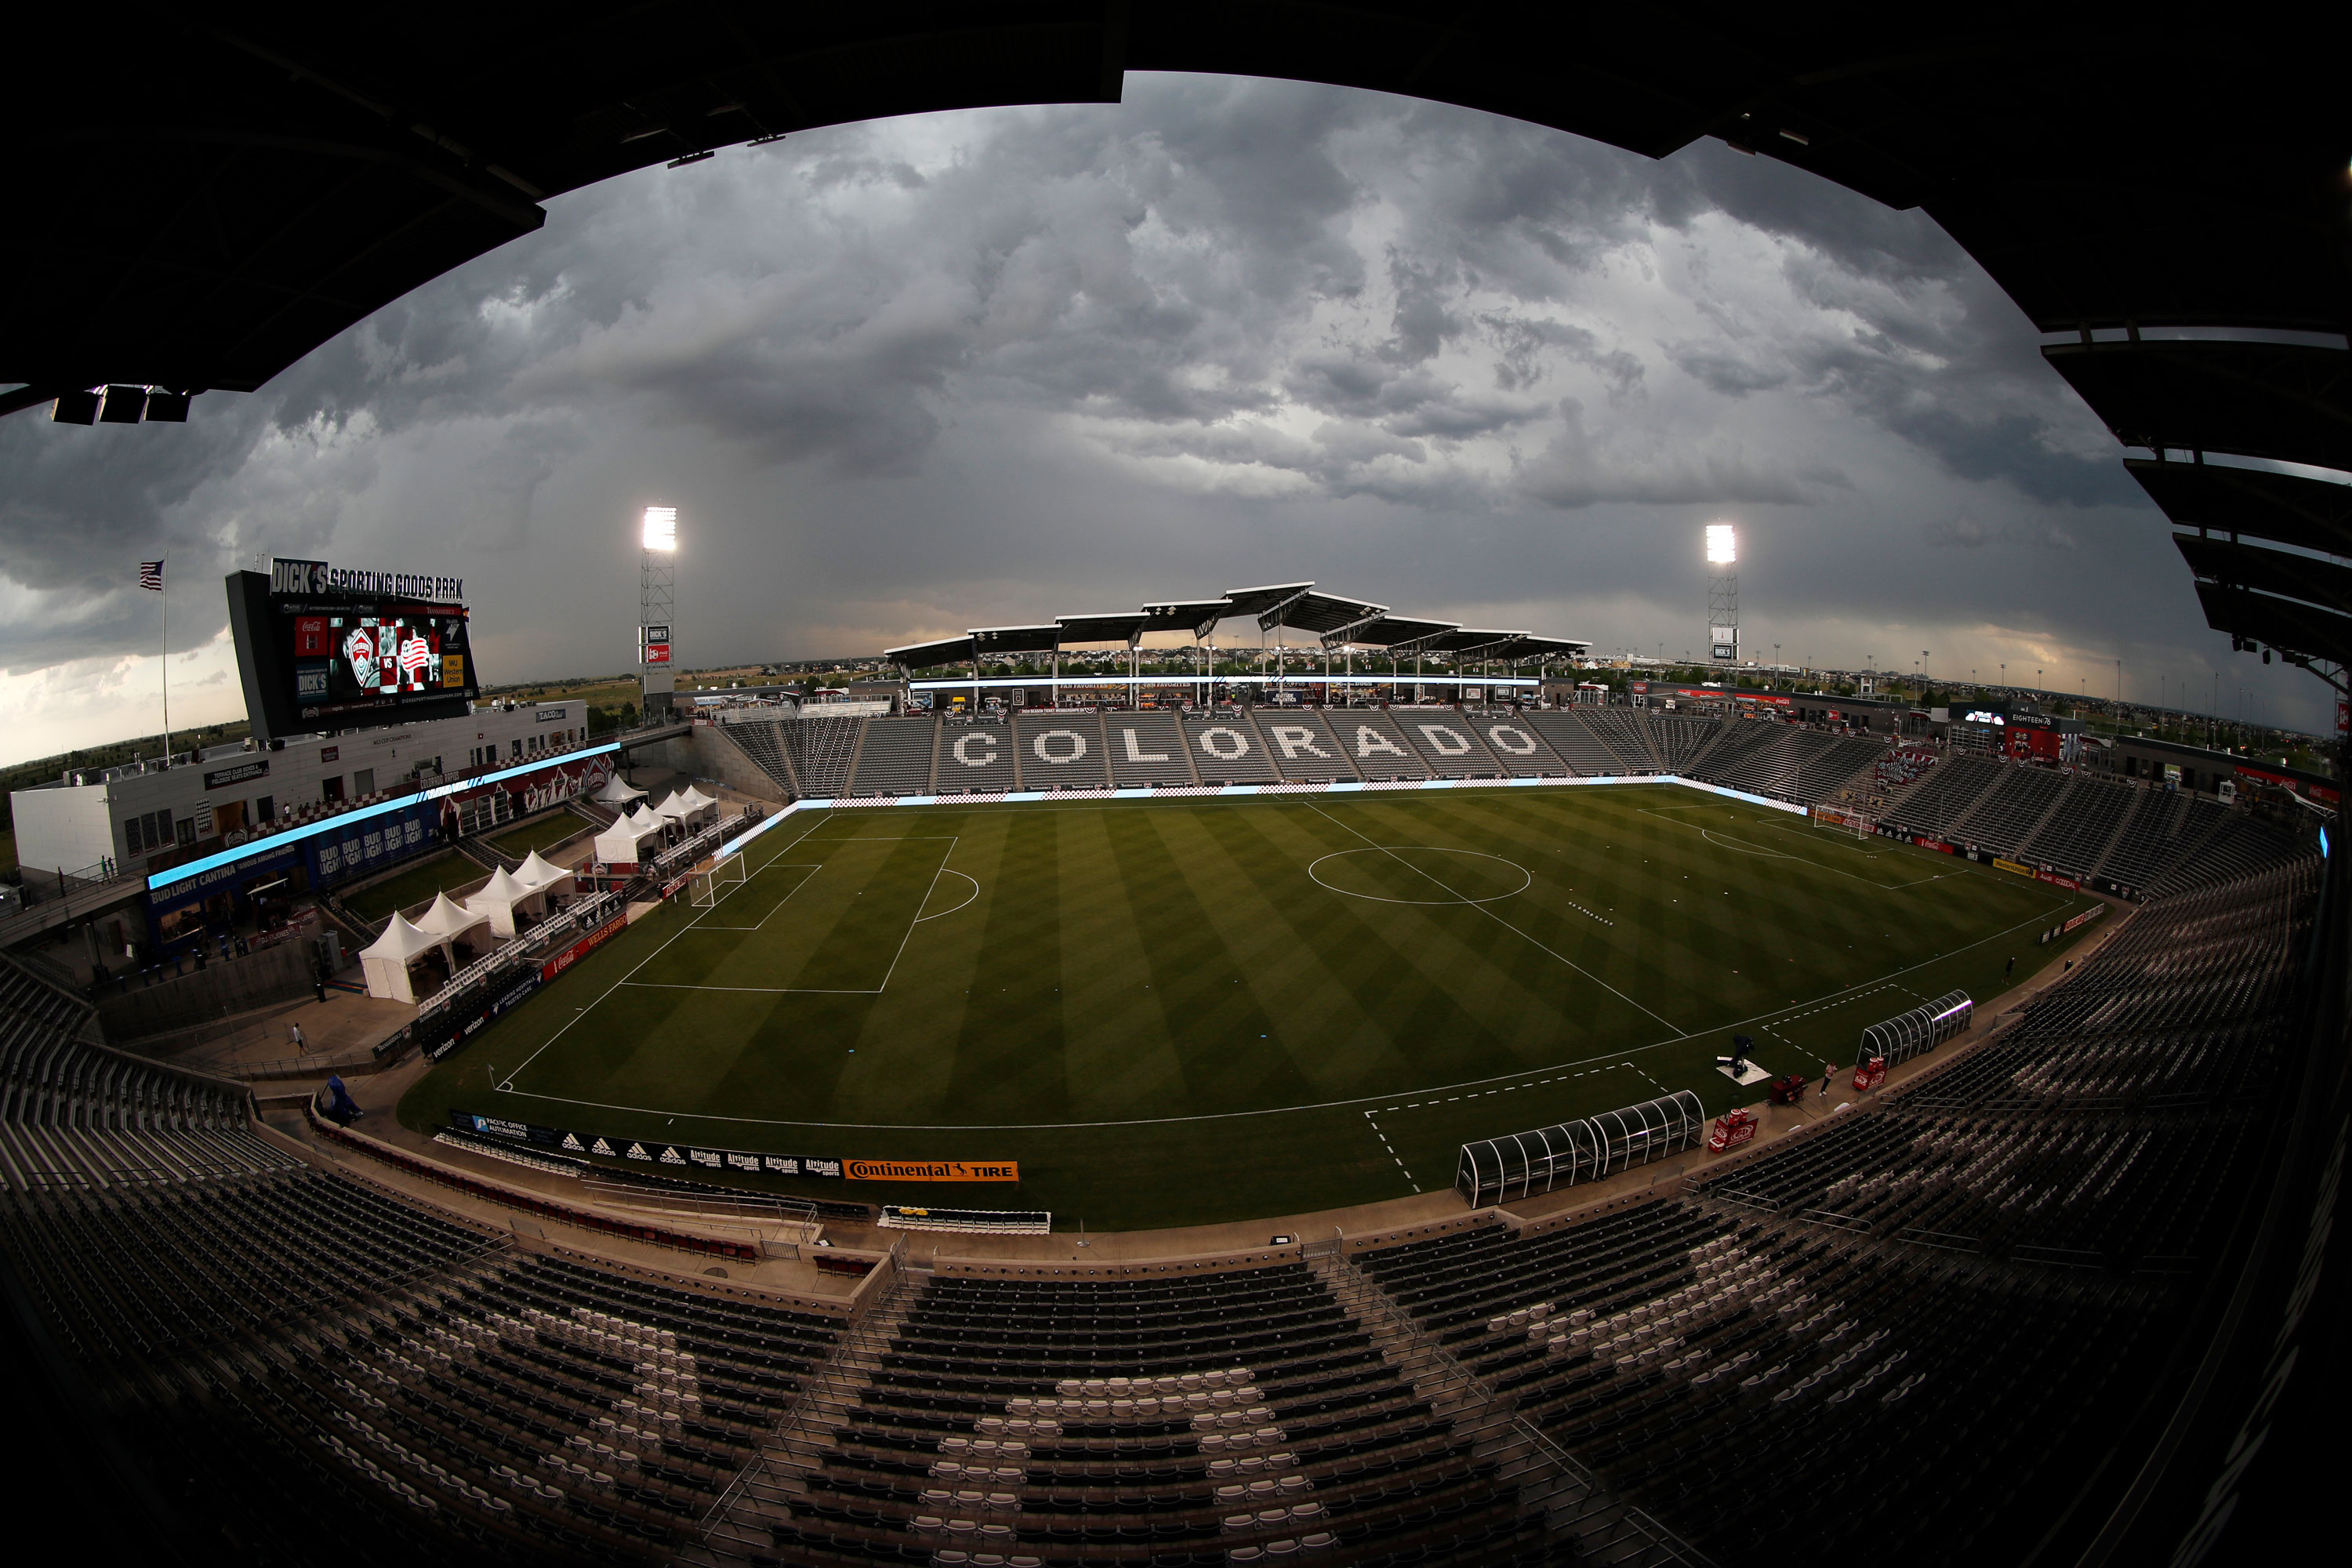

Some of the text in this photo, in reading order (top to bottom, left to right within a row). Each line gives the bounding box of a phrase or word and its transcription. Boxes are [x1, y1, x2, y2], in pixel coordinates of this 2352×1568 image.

[271, 561, 463, 599] DICK'S SPORTING GOODS PARK
[383, 658, 393, 668] VS
[299, 673, 327, 691] DICK'S
[539, 710, 556, 720] TACO
[2013, 714, 2051, 726] EIGHTEEN 76
[389, 734, 412, 743] CHAMPIONS
[953, 725, 1536, 767] COLORADO
[212, 768, 263, 786] FIELDSIDE SEATS ENTRANCE
[214, 770, 231, 779] TERRACE
[420, 775, 444, 789] COLORADO
[384, 825, 401, 840] BUD
[404, 818, 420, 833] BUD
[364, 831, 381, 847] BUD
[342, 838, 361, 855] BUD
[257, 851, 275, 864] AMONG
[275, 845, 295, 858] FRIENDS
[320, 846, 339, 862] BUD
[151, 865, 236, 905] BUD LIGHT CANTINA
[588, 915, 627, 947] WELLS FARGO
[499, 989, 516, 1005] LEADING
[505, 993, 522, 1007] TRUSTED
[463, 1016, 485, 1035] verizon
[376, 1032, 402, 1052] TRANSAMERICA
[433, 1037, 455, 1058] verizon
[486, 1117, 528, 1131] PACIFIC OFFICE
[489, 1124, 527, 1138] AUTOMATION
[561, 1142, 586, 1152] adidas
[591, 1146, 616, 1157] adidas
[626, 1151, 652, 1161] adidas
[659, 1156, 687, 1165] adidas
[690, 1149, 720, 1162] Altitude
[728, 1152, 759, 1165] Altitude
[765, 1156, 798, 1168] Altitude
[805, 1159, 839, 1170] Altitude
[849, 1161, 1013, 1179] Continental TIRE
